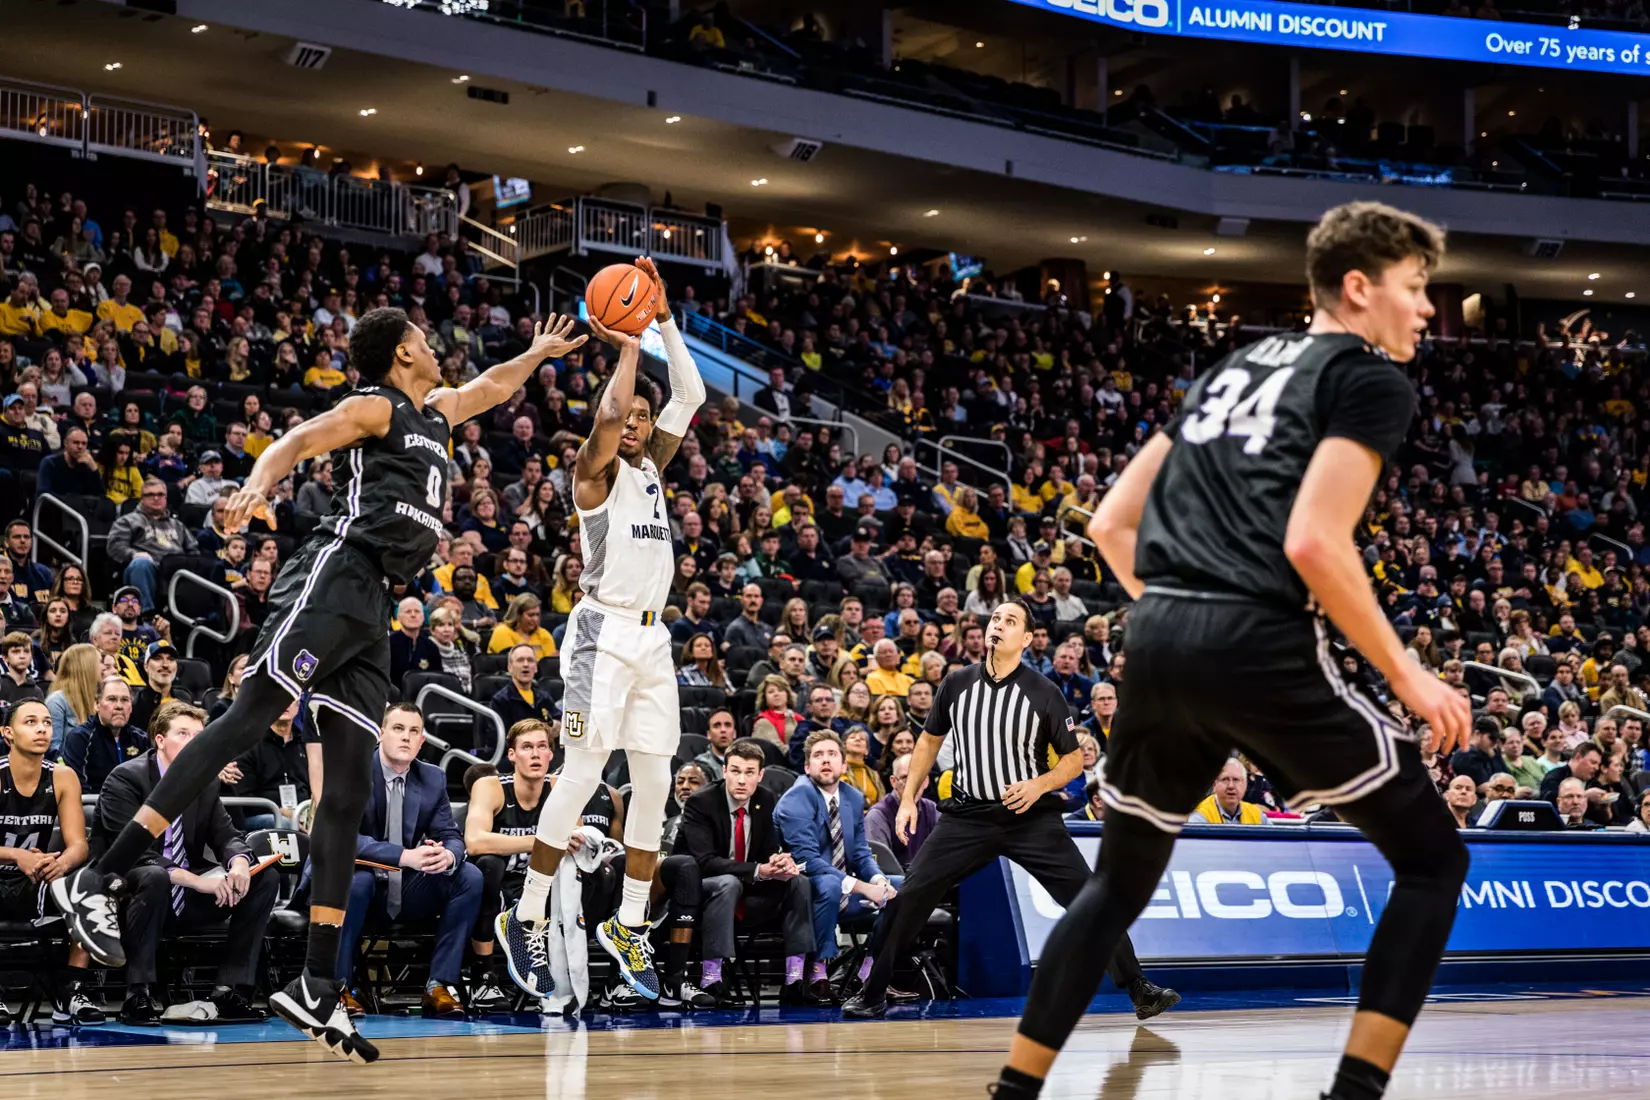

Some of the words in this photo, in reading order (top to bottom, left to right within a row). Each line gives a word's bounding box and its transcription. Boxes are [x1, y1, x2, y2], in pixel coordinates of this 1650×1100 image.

[1188, 6, 1272, 32] ALUMNI
[1278, 14, 1387, 42] DISCOUNT
[295, 47, 325, 68] 117
[1486, 33, 1533, 54] Over
[1538, 37, 1561, 57] 75
[1566, 44, 1616, 64] years
[1620, 44, 1641, 63] of
[1182, 367, 1295, 455] 34
[425, 464, 442, 509] 0
[645, 483, 660, 520] 2
[565, 710, 585, 739] MU
[1518, 811, 1536, 823] POSS
